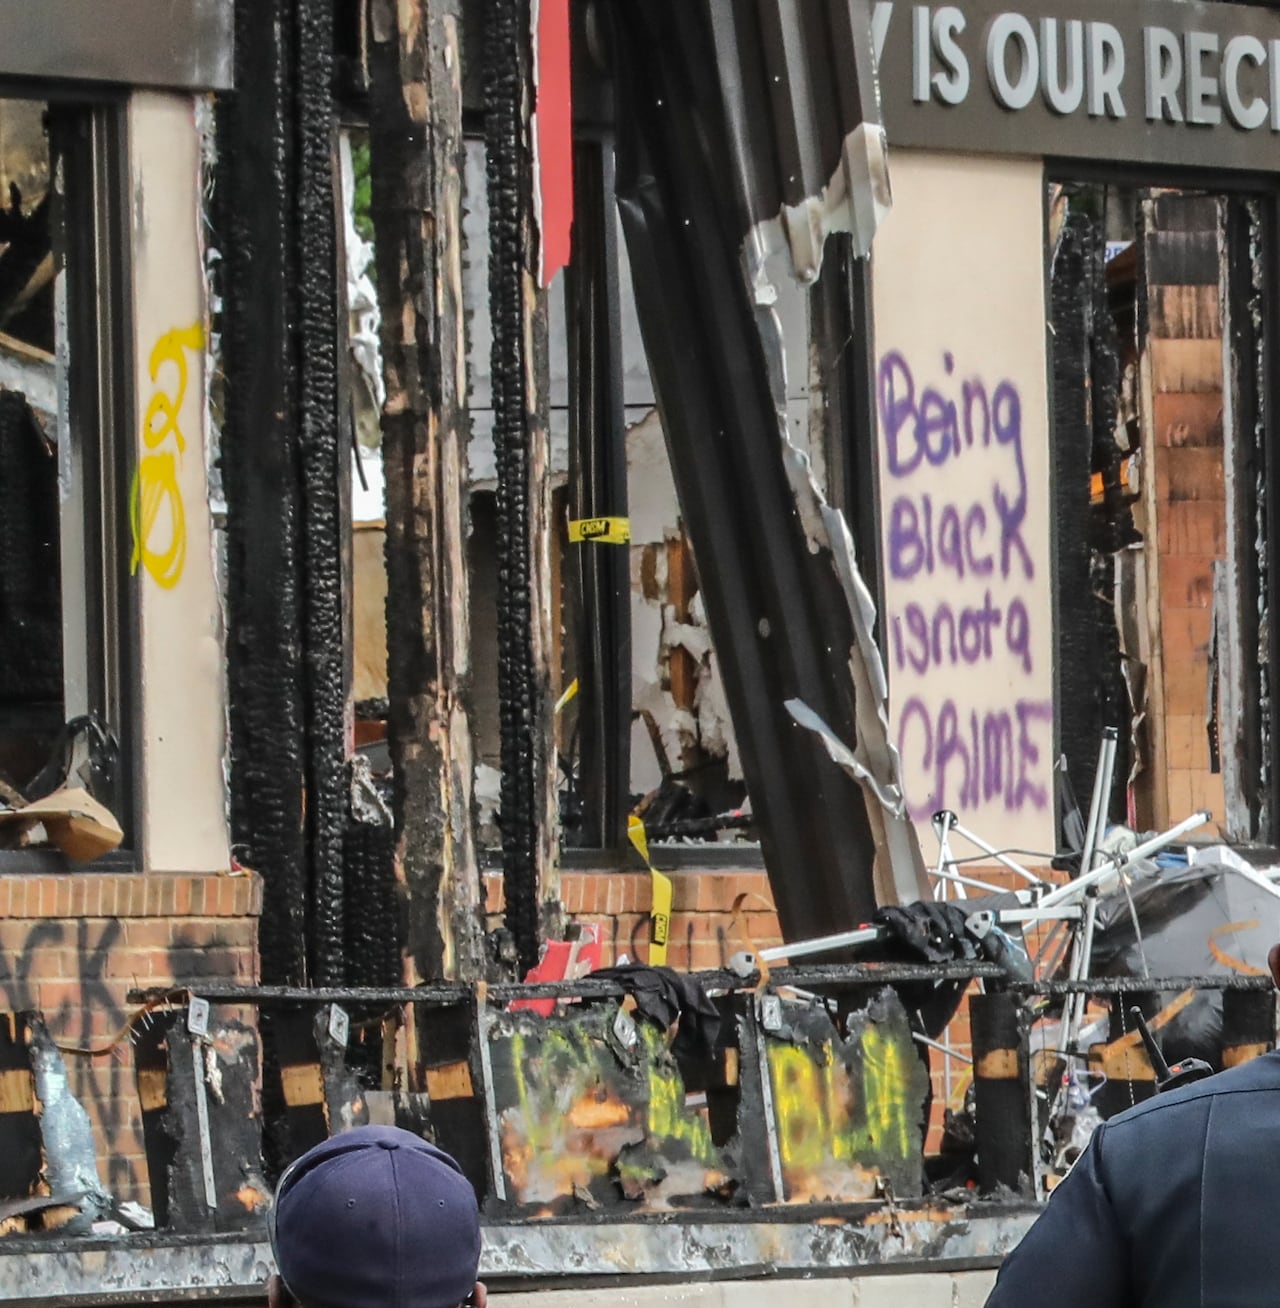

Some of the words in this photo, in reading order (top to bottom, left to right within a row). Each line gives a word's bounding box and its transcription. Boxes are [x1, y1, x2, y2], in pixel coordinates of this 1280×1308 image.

[912, 5, 970, 105] IS
[985, 12, 1127, 119] OUR
[879, 349, 1028, 492] Being
[889, 483, 1034, 580] Black
[932, 588, 1001, 665] not
[898, 696, 1053, 822] CRIME
